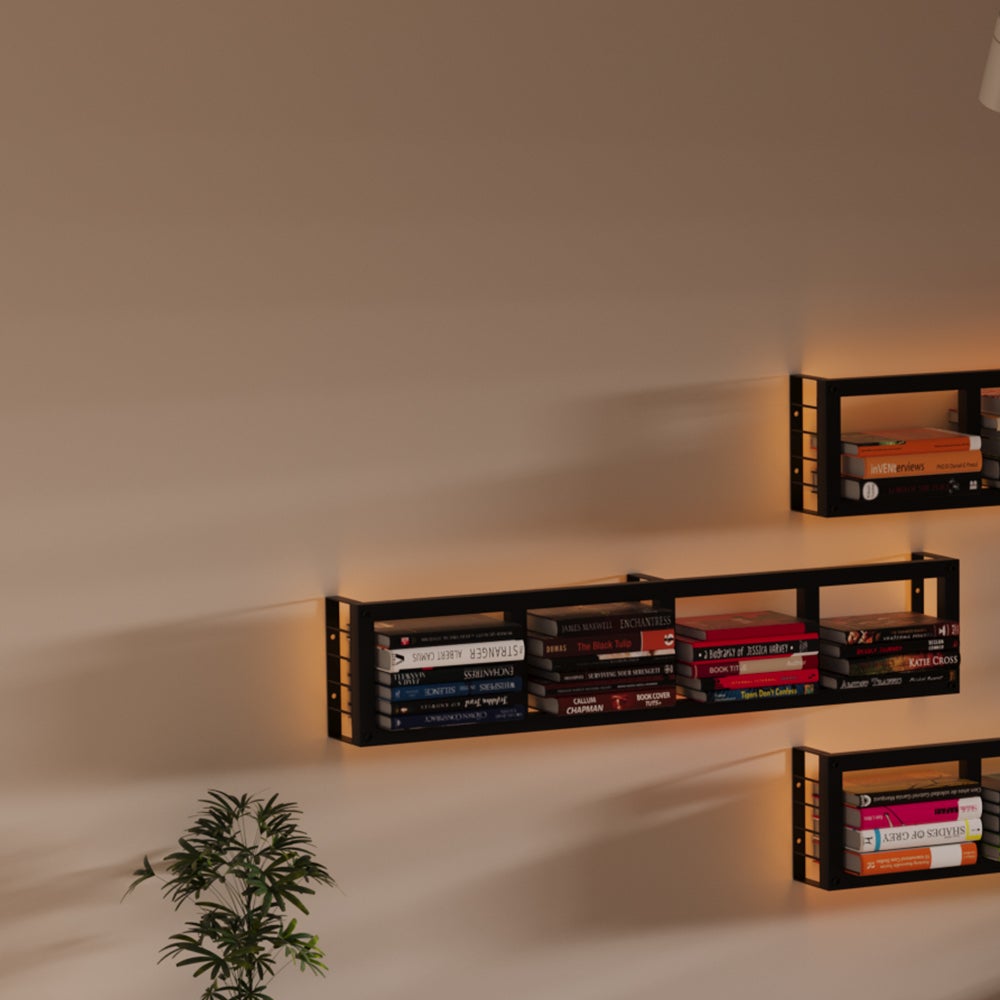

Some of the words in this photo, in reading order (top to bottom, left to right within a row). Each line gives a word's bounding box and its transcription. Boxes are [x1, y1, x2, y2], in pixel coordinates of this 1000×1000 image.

[582, 621, 612, 631] MAXWELL
[620, 616, 672, 629] ENCHANTRESS
[470, 645, 519, 657] STRANGER
[592, 641, 613, 650] Black
[746, 644, 768, 656] JESSICA
[769, 643, 789, 654] HARVEY
[412, 652, 435, 662] CAMUS
[439, 649, 462, 661] ALBERT
[909, 657, 931, 667] KATIE
[932, 655, 959, 666] CROSS
[464, 665, 514, 680] ENCHANTRESS
[709, 666, 728, 674] BOOK
[424, 685, 456, 697] SILENCE
[479, 682, 515, 692] WHISPERS
[573, 696, 597, 705] CALLUM
[636, 693, 652, 701] BOOK
[652, 691, 671, 699] COVER
[741, 690, 758, 700] Tigers
[758, 688, 775, 698] Don't
[566, 704, 605, 715] CHAPMAN
[424, 713, 463, 723] CONSPIRACY
[882, 831, 910, 843] GREY
[911, 829, 925, 839] OF
[926, 825, 966, 838] SHADES
